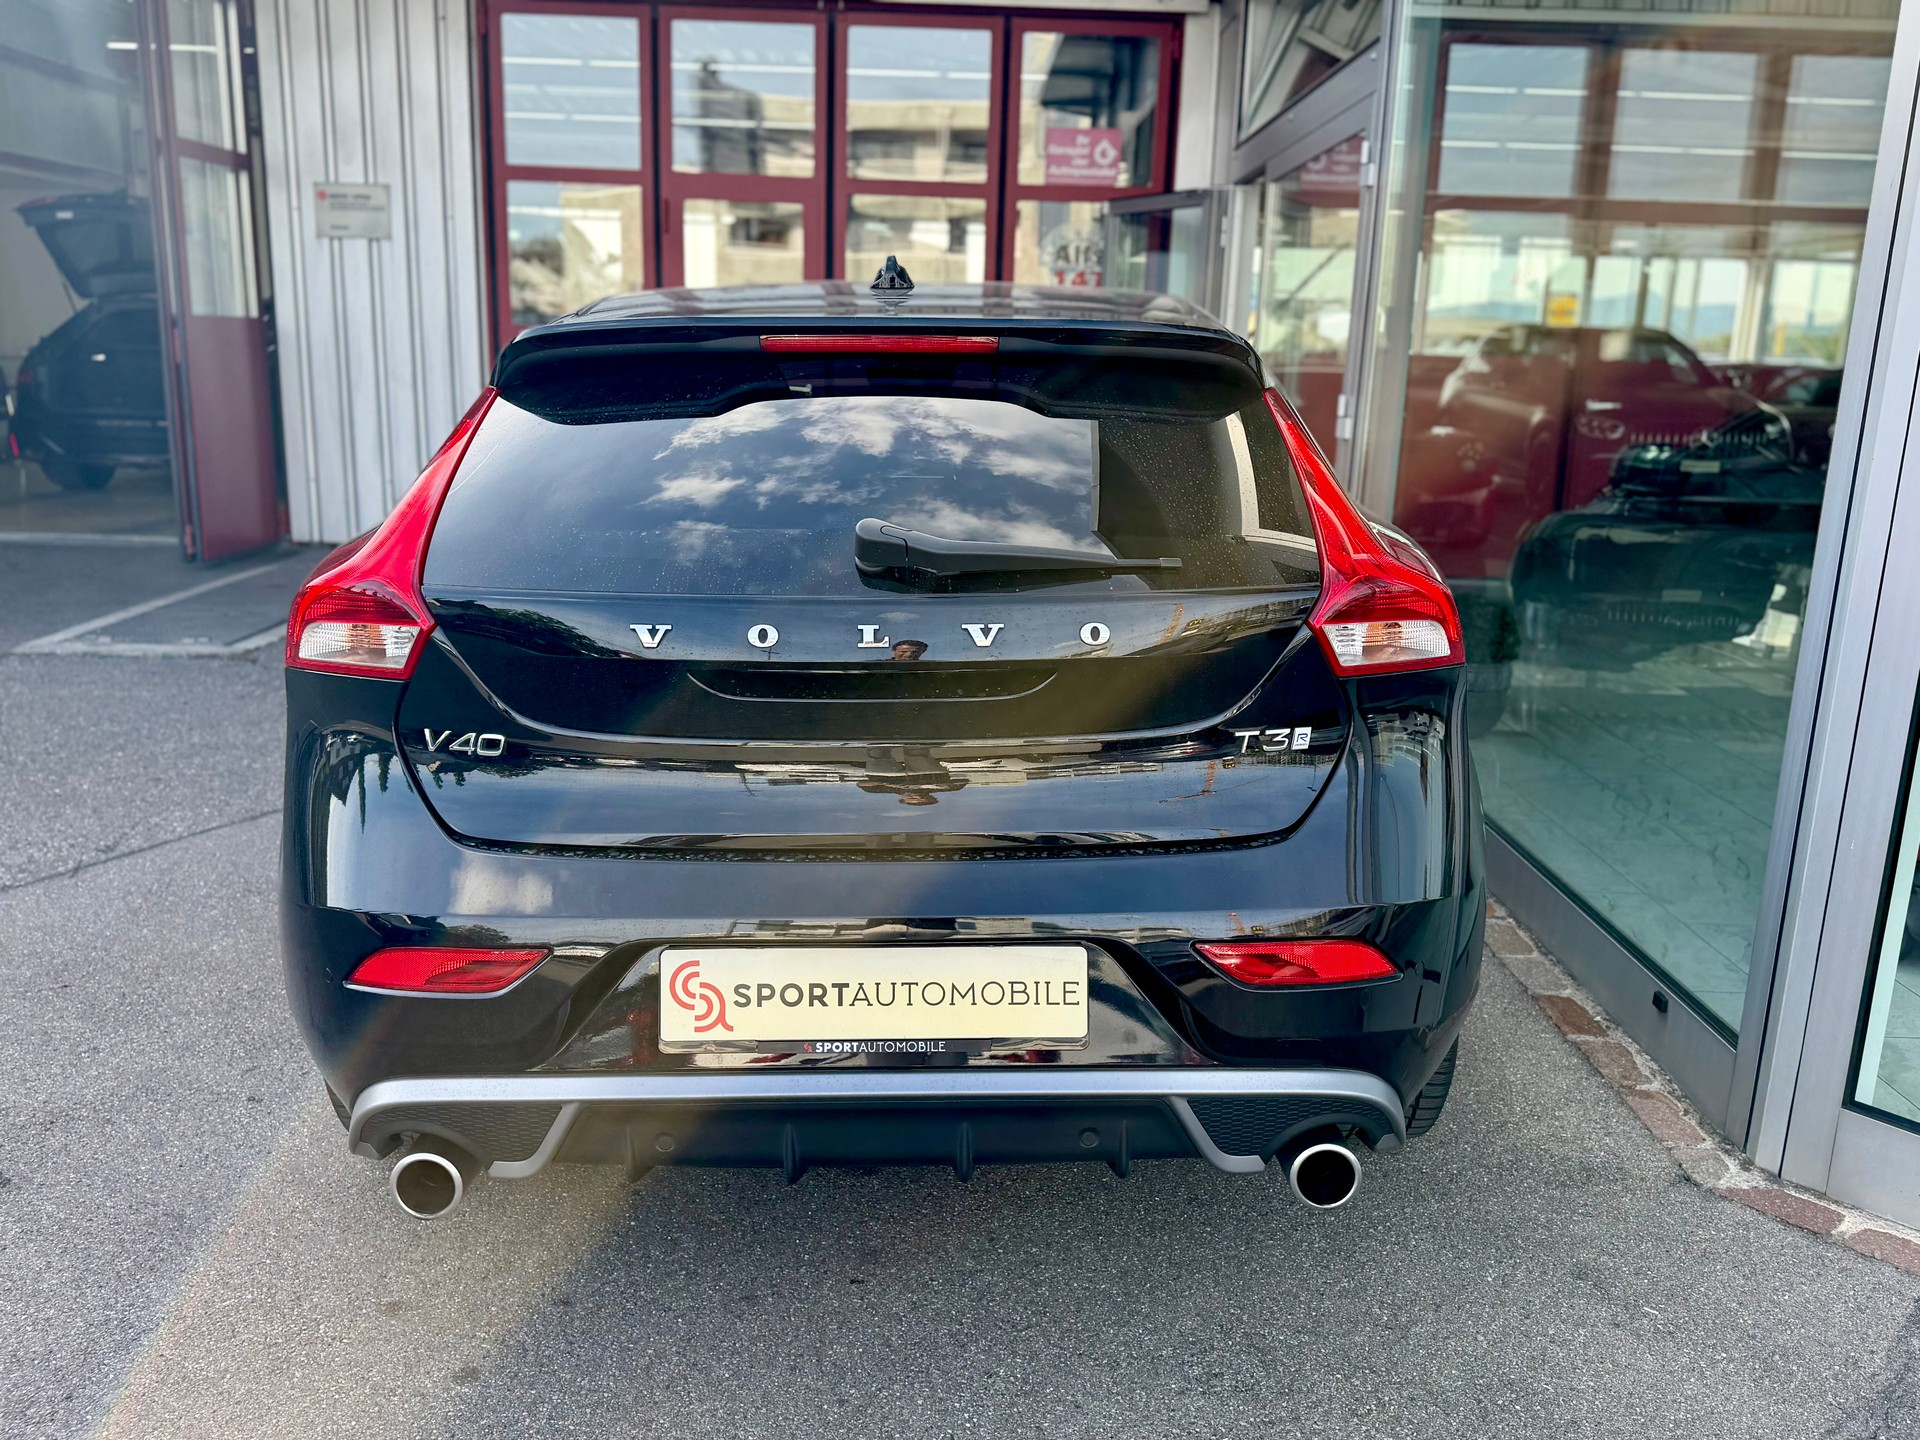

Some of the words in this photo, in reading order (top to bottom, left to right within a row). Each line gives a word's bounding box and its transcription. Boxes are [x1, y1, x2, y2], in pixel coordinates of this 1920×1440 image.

[629, 622, 1111, 649] VOLVO
[423, 728, 505, 757] V40
[1234, 728, 1291, 753] T3
[733, 980, 1080, 1008] SPORTAUTOMOBILE
[815, 1041, 946, 1053] SPORTAUTOMOBILE
